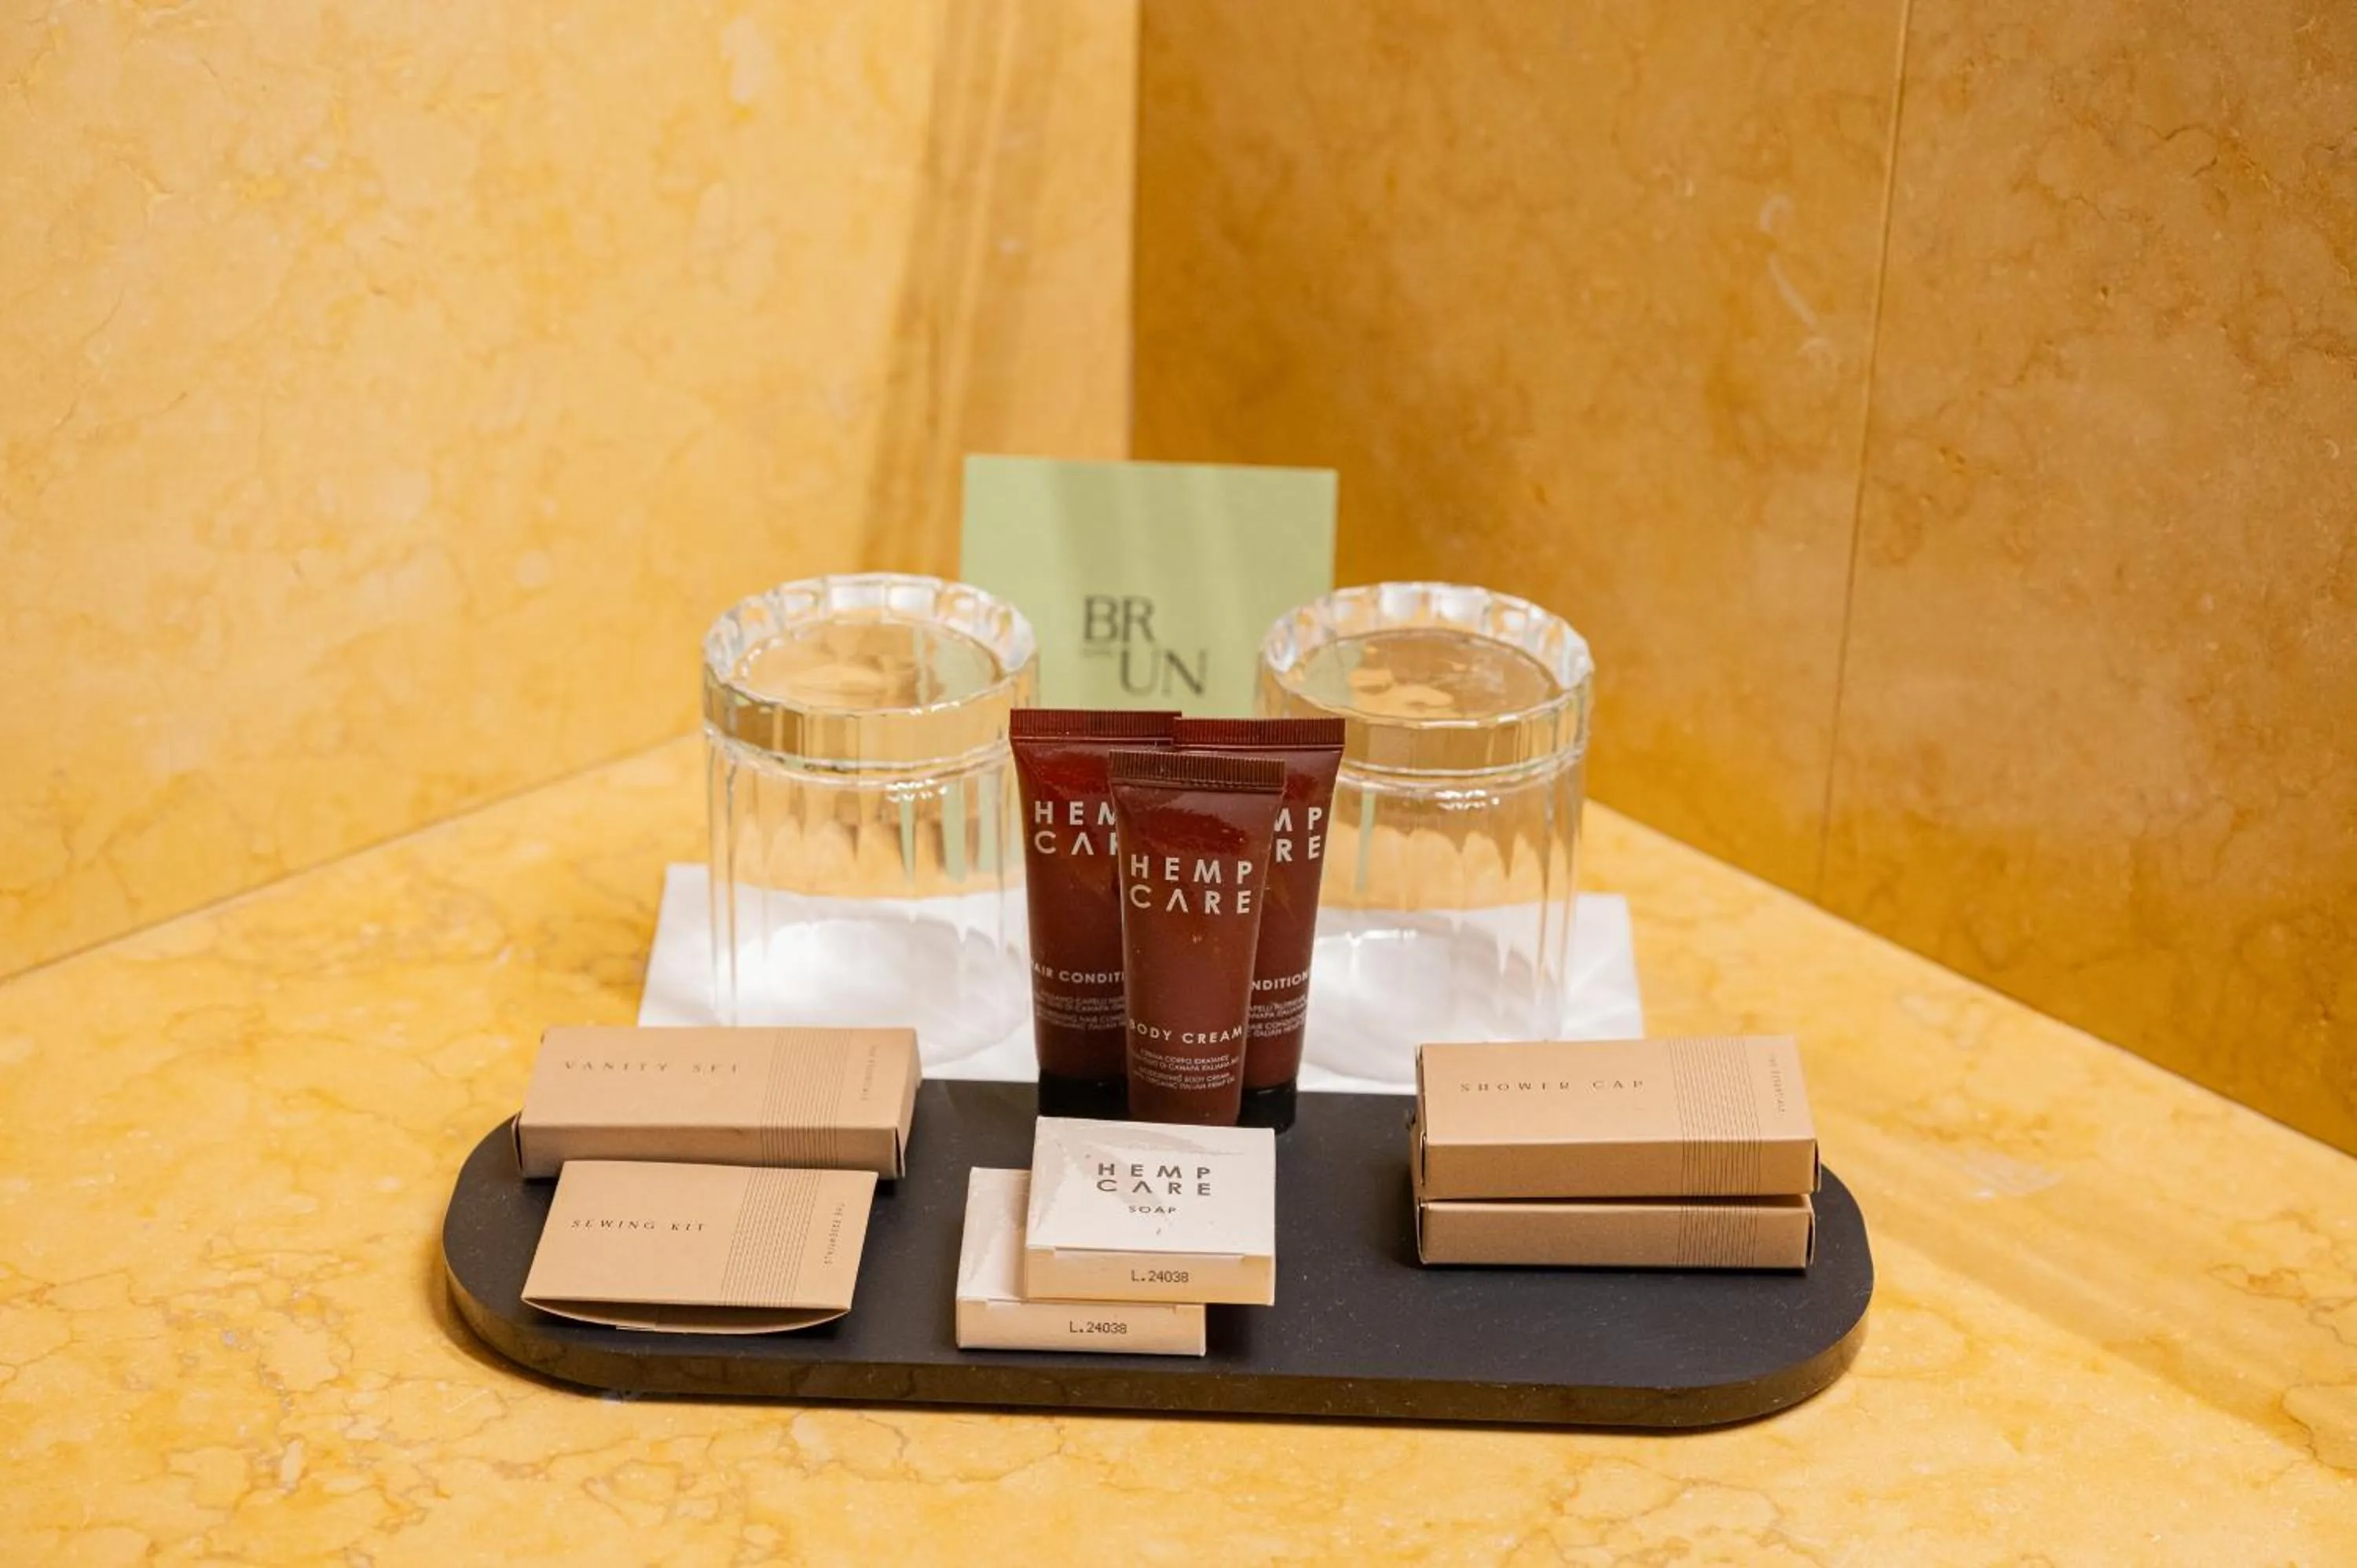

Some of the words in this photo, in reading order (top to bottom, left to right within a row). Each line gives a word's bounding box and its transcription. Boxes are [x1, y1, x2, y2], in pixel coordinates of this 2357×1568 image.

[1083, 595, 1156, 644] BR
[1119, 648, 1207, 696] UN
[1035, 800, 1116, 825] HEM
[1274, 807, 1322, 832] MP
[1035, 830, 1118, 855] CA
[1276, 835, 1321, 862] RE
[1131, 854, 1253, 885] HEMP
[1130, 884, 1252, 915] CARE
[1058, 969, 1124, 984] CONDITI
[1252, 970, 1308, 991] NDITION
[1130, 1019, 1171, 1041] BODY
[1182, 1025, 1242, 1044] CREAM
[565, 1061, 668, 1072] VANITY
[1460, 1082, 1570, 1092] SHOWER
[1592, 1080, 1644, 1090] CAP
[1098, 1163, 1211, 1179] HEMP
[1096, 1179, 1211, 1196] CARE
[1128, 1206, 1177, 1214] SOAP
[571, 1219, 655, 1230] SEWING
[671, 1222, 705, 1232] KIT
[1131, 1269, 1189, 1284] L.24038
[1069, 1321, 1127, 1335] L.24038
